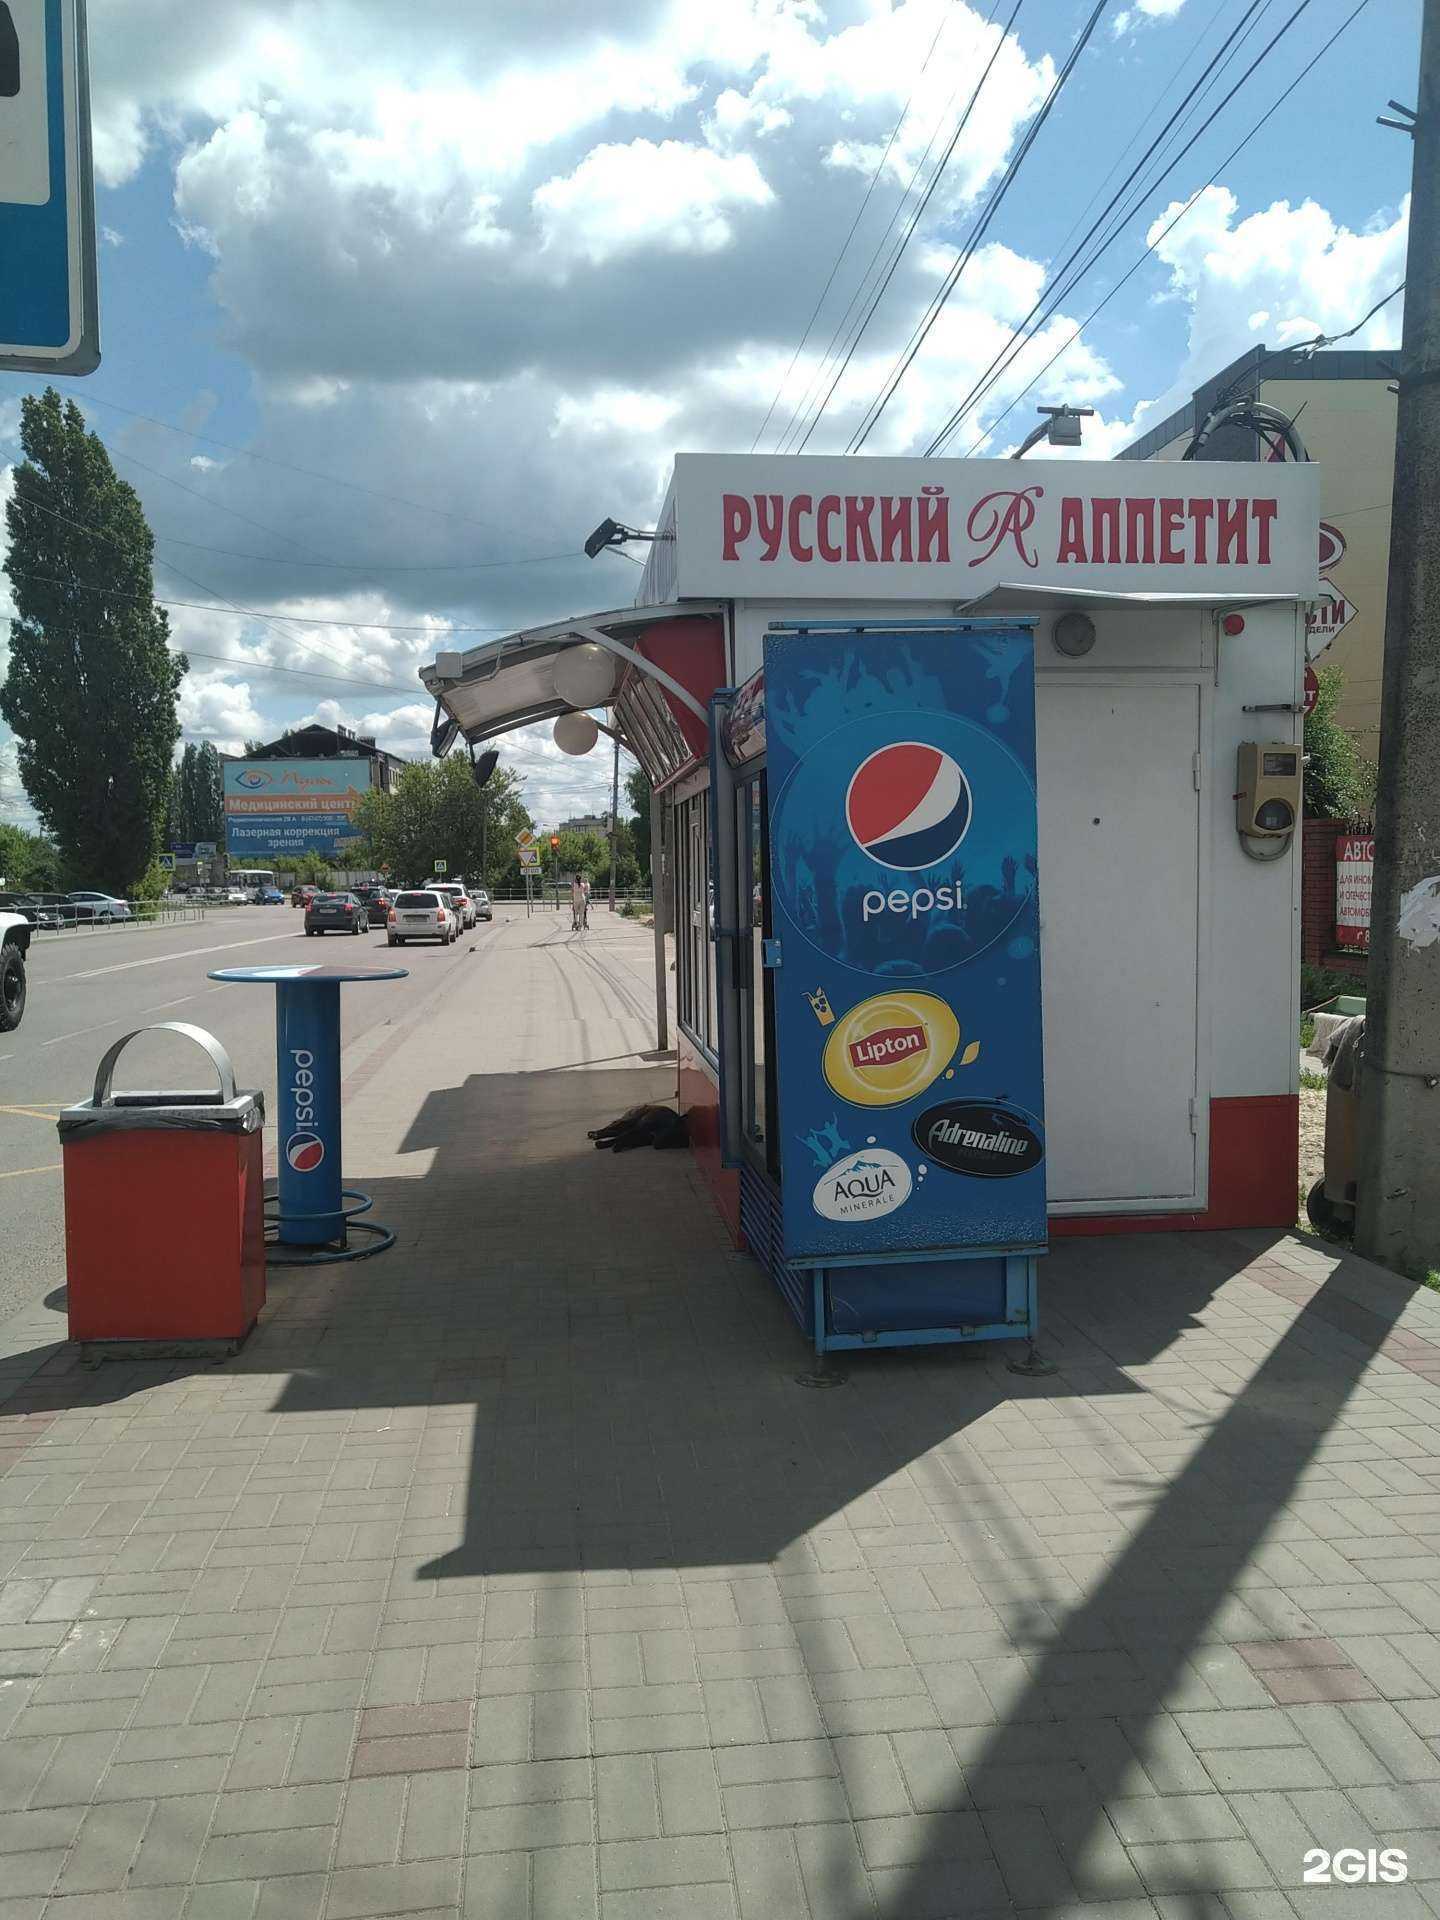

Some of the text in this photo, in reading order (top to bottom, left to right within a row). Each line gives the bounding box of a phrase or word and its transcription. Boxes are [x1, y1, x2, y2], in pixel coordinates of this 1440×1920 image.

[722, 486, 951, 563] РУССКИЙ
[1056, 496, 1278, 565] АППЕТИТ
[229, 798, 318, 812] Медицинский
[232, 827, 340, 839] Лазерная коррекция
[267, 838, 304, 849] зрения
[863, 880, 962, 921] pepsi
[856, 1032, 920, 1062] Lipton
[290, 1049, 319, 1126] pepsi
[928, 1119, 1029, 1156] Adrenaline
[833, 1169, 896, 1201] AQUA
[839, 1194, 895, 1215] MINERALE
